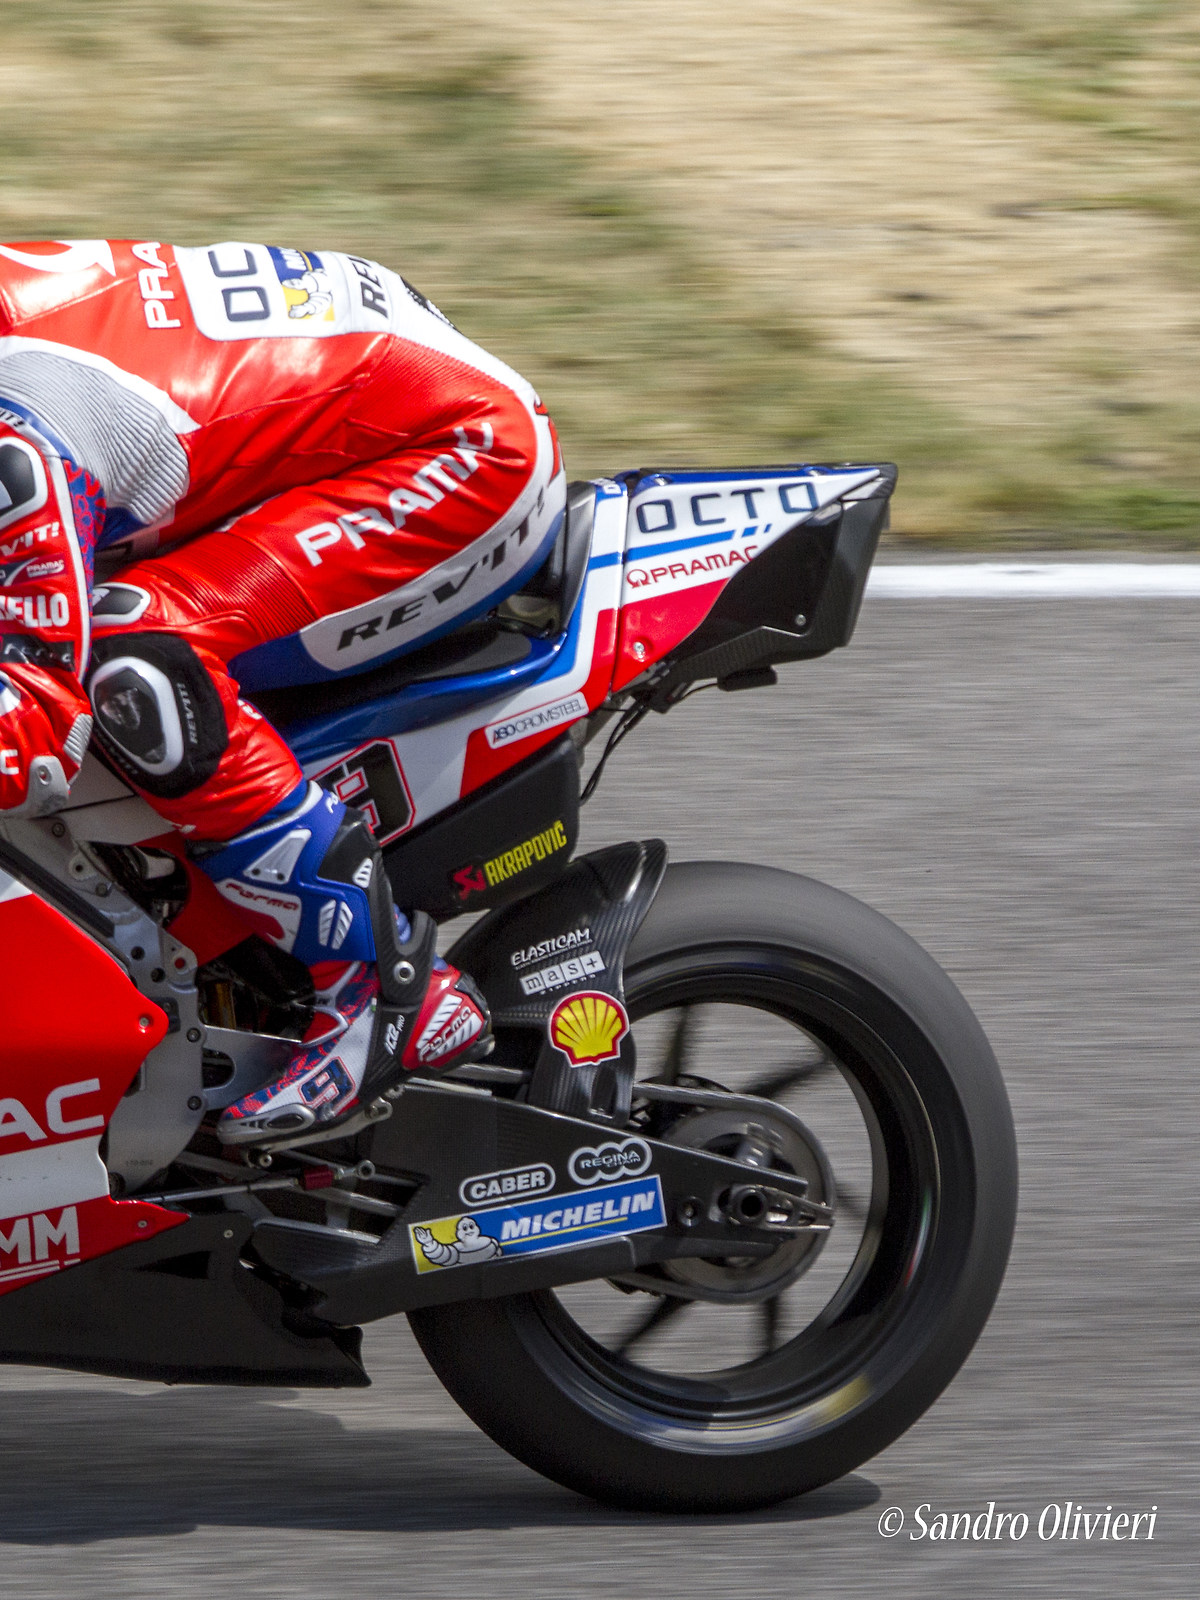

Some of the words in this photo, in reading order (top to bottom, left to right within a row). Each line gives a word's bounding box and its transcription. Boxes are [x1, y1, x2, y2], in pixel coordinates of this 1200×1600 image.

[636, 482, 819, 533] OCTO
[650, 545, 759, 583] PRAMAC
[511, 928, 590, 967] ELASTICAM
[581, 1150, 640, 1169] REGINA
[469, 1171, 547, 1200] CABER
[500, 1190, 656, 1241] MICHELIN
